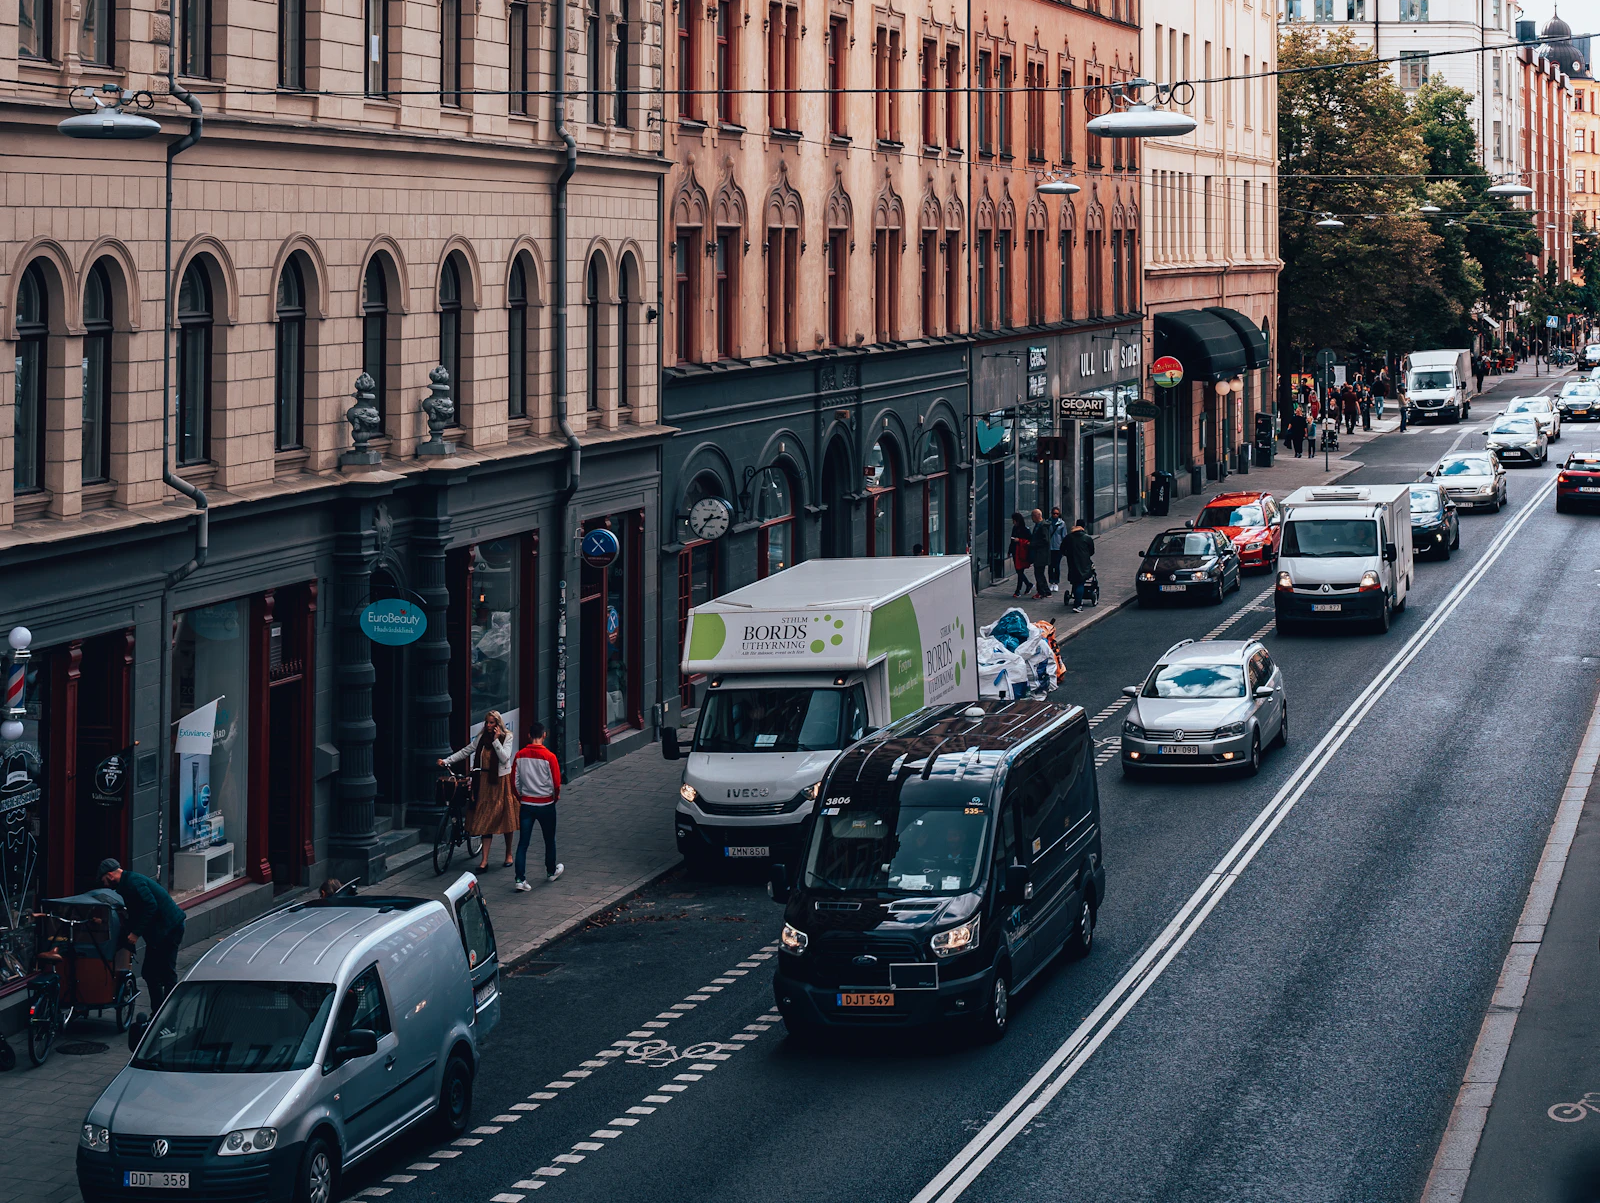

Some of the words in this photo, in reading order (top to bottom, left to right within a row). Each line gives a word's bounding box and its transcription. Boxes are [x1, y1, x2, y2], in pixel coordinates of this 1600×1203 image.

[1081, 352, 1095, 377] ULL
[1103, 349, 1114, 372] LIN
[1121, 343, 1140, 369] SIDEN
[1061, 399, 1104, 410] GEOART
[368, 611, 420, 626] EuroBeauty
[743, 624, 807, 640] BORDS
[742, 641, 806, 650] UTHYRNING
[927, 638, 953, 677] BORDS
[180, 728, 211, 739] Exuviance
[727, 788, 769, 798] IVECO
[825, 796, 851, 806] 3806
[964, 807, 979, 815] 535
[732, 847, 747, 856] ZMN
[749, 847, 766, 856] 850
[845, 994, 866, 1005] DJT
[869, 994, 890, 1005] 549
[131, 1173, 153, 1185] DDT
[163, 1174, 186, 1186] 358
